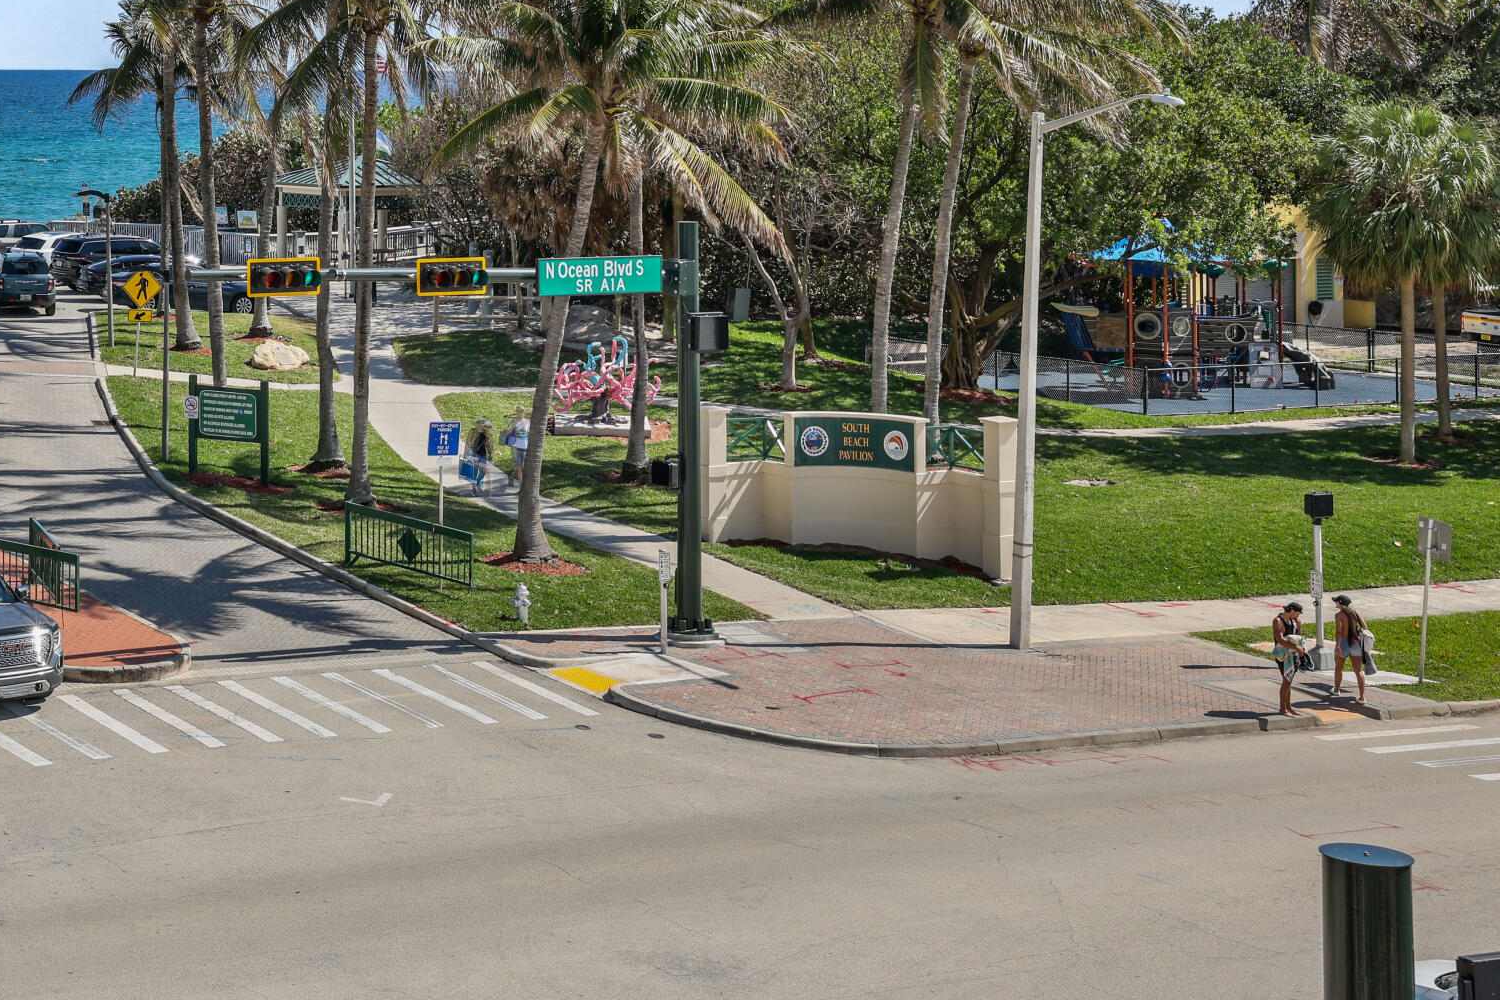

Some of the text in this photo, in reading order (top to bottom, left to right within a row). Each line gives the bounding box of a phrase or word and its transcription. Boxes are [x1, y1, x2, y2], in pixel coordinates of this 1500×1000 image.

[546, 259, 644, 279] N Ocean Blvd S
[576, 278, 626, 292] SR A1A
[842, 422, 870, 433] SOUTH
[843, 436, 869, 447] BEACH
[839, 450, 874, 461] PAVILION
